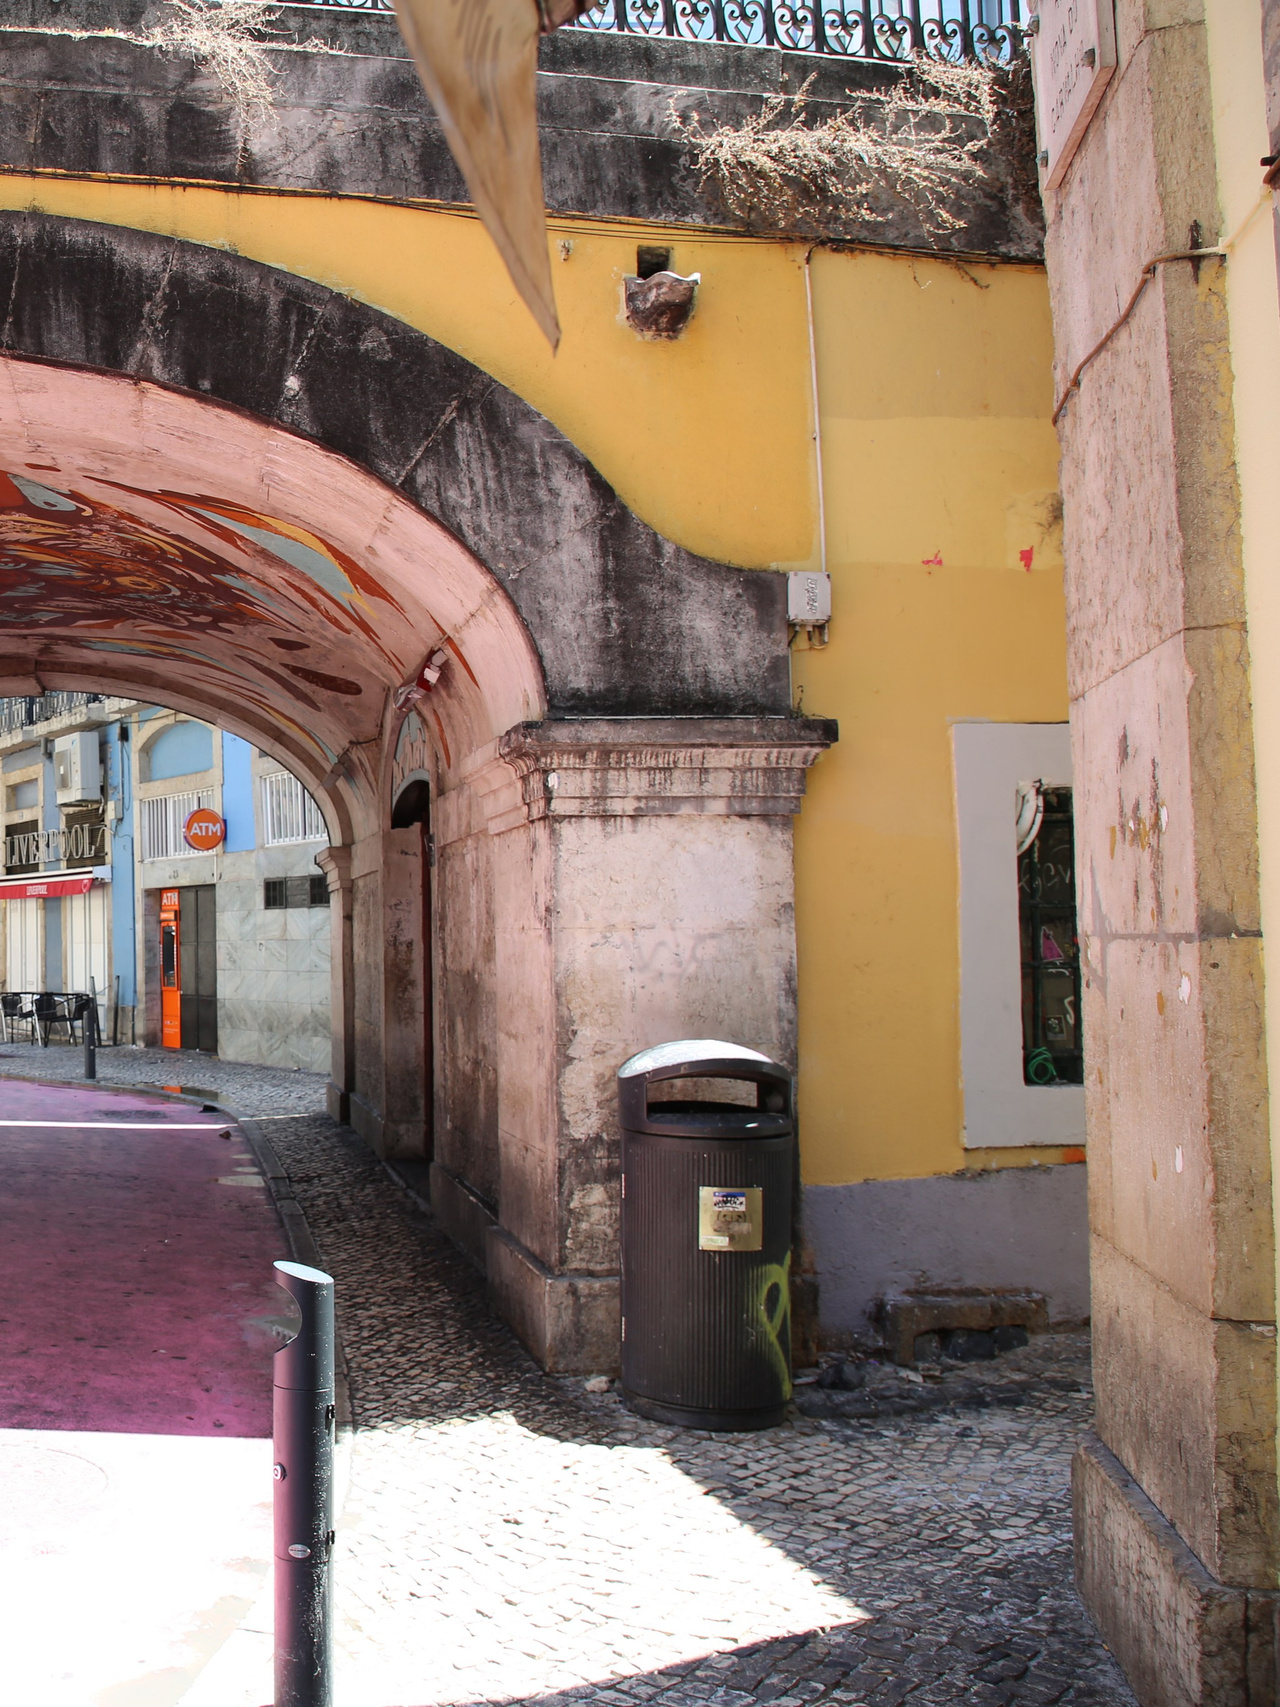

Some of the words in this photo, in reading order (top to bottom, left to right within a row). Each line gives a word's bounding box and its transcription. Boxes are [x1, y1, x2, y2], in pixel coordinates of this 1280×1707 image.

[189, 822, 221, 836] ATM
[5, 824, 95, 867] LIVERPOOL
[162, 892, 178, 906] ATM
